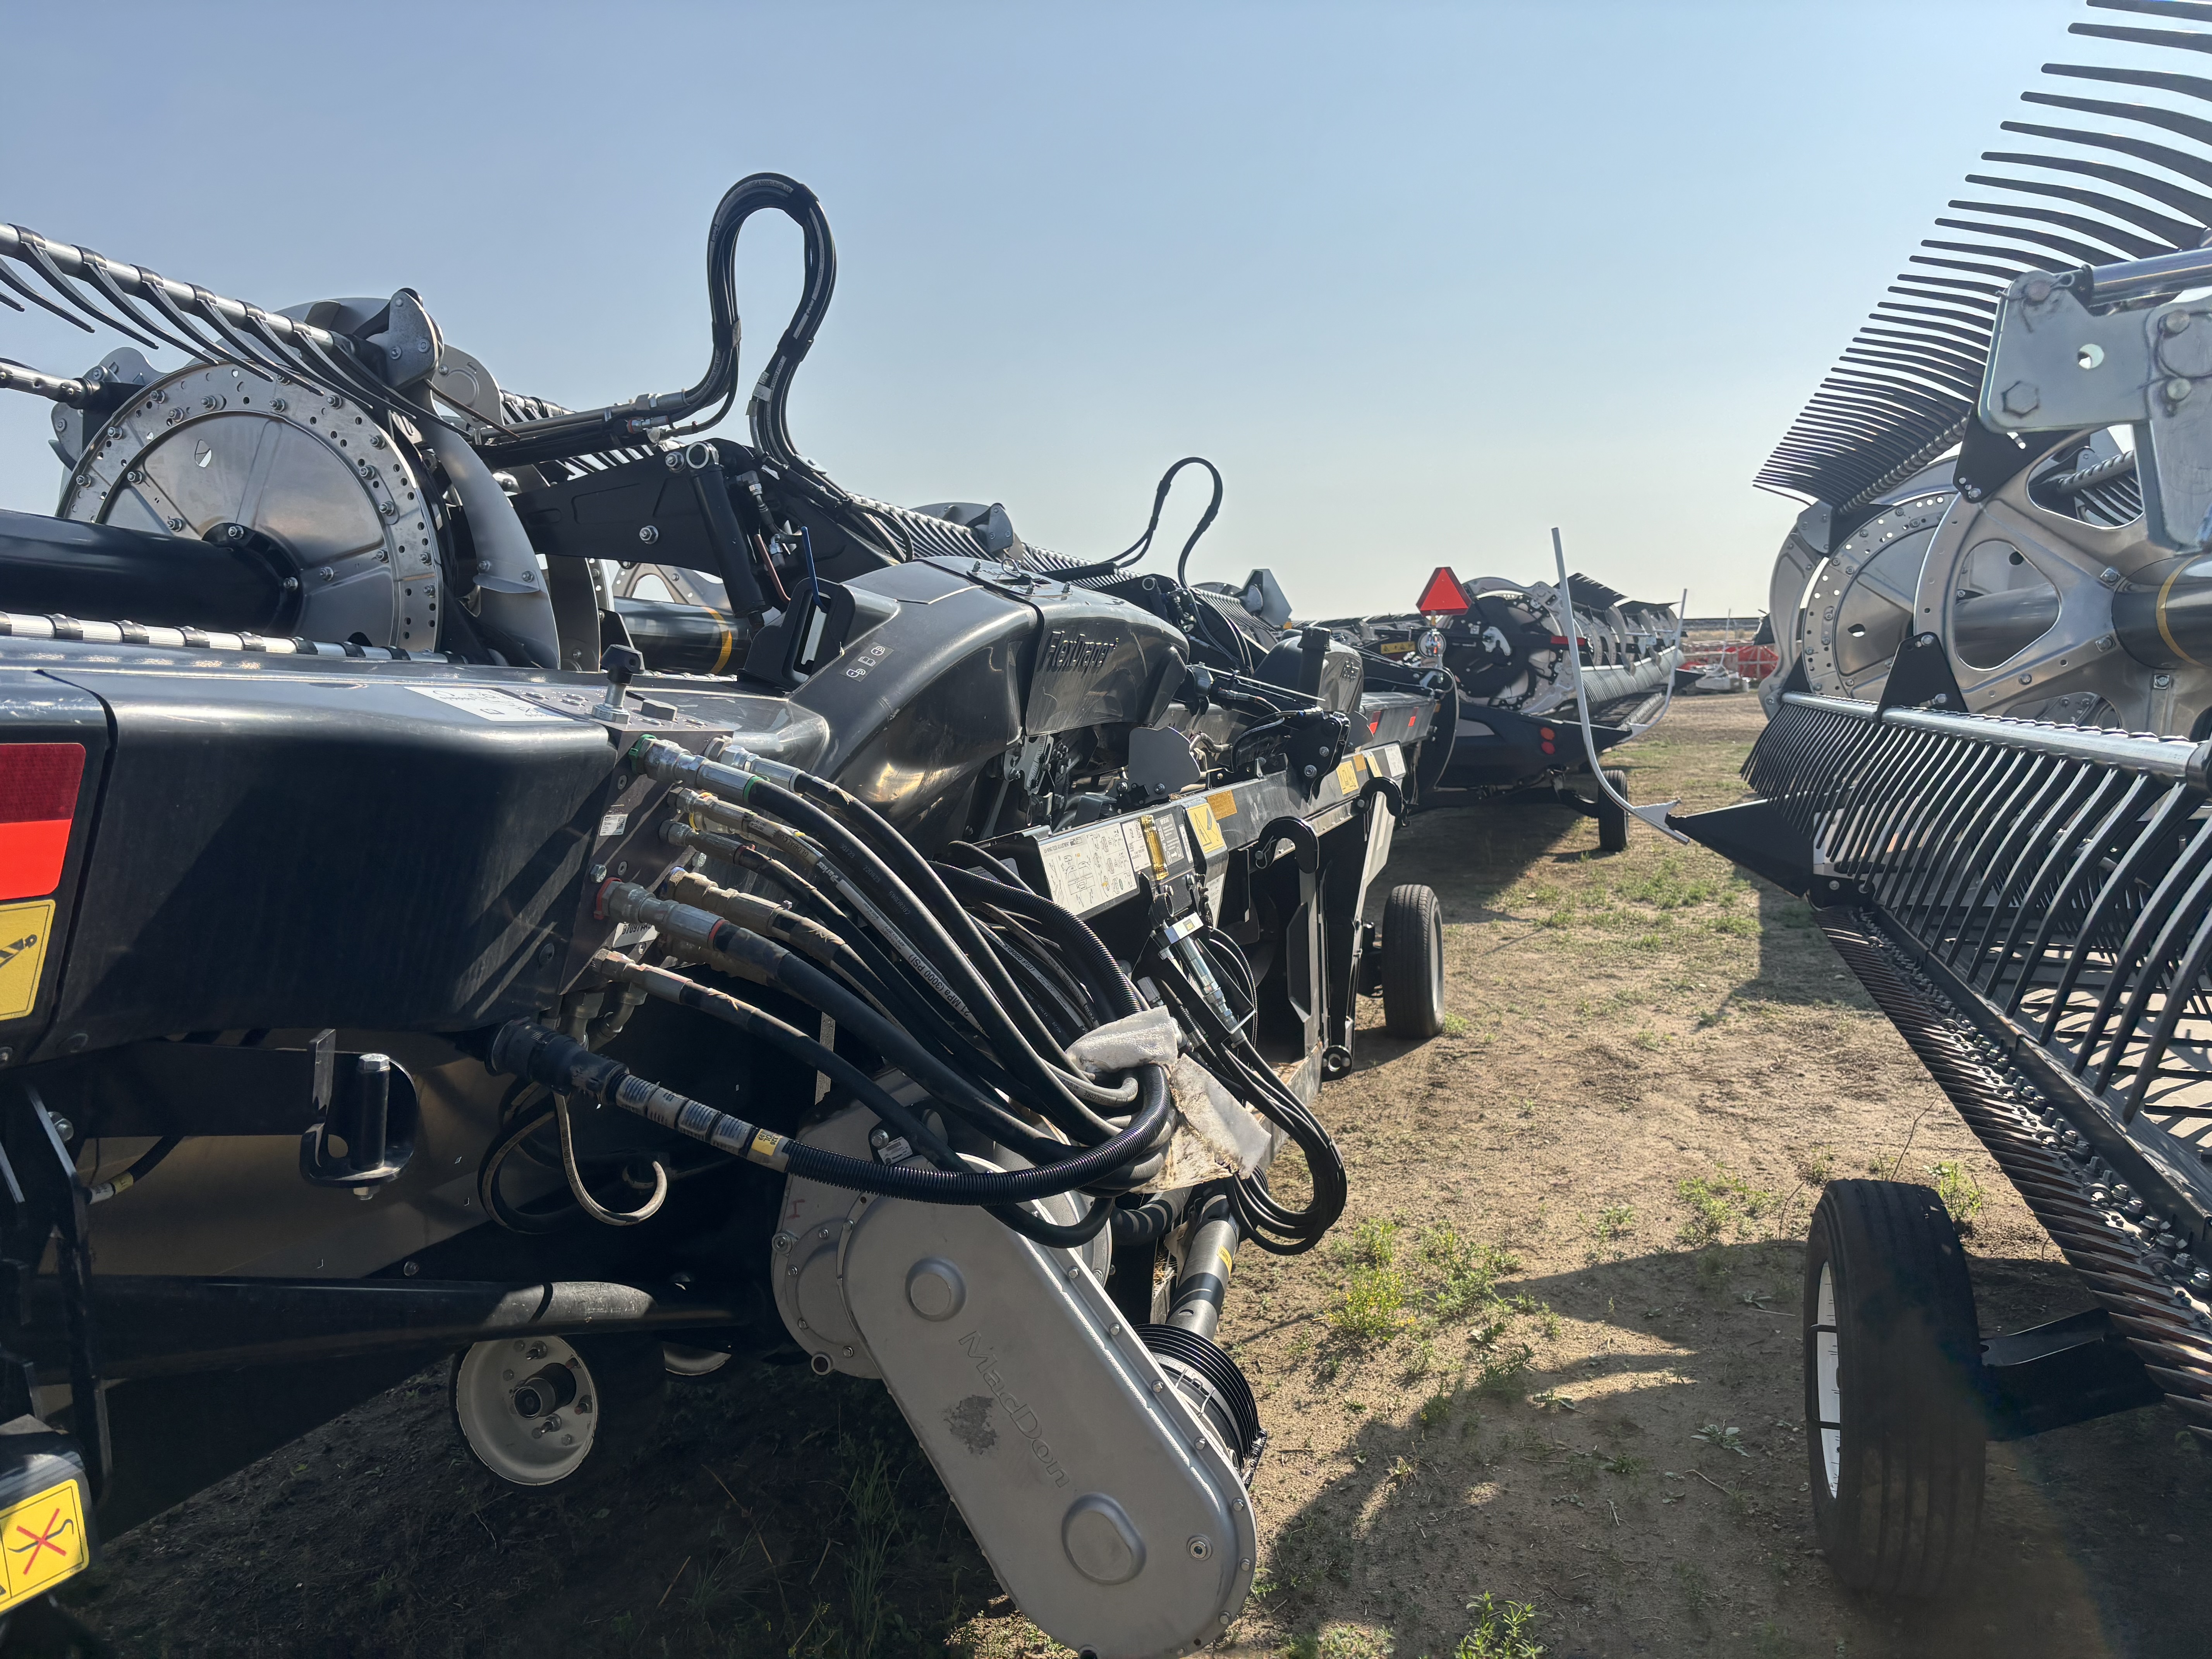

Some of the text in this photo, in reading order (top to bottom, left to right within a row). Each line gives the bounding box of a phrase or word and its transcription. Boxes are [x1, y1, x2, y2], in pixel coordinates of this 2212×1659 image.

[1042, 631, 1117, 673] FlexDraper
[816, 861, 839, 883] Parker
[908, 954, 971, 1017] 21 MPa (3000 PSI)
[958, 1331, 1070, 1488] MacDon
